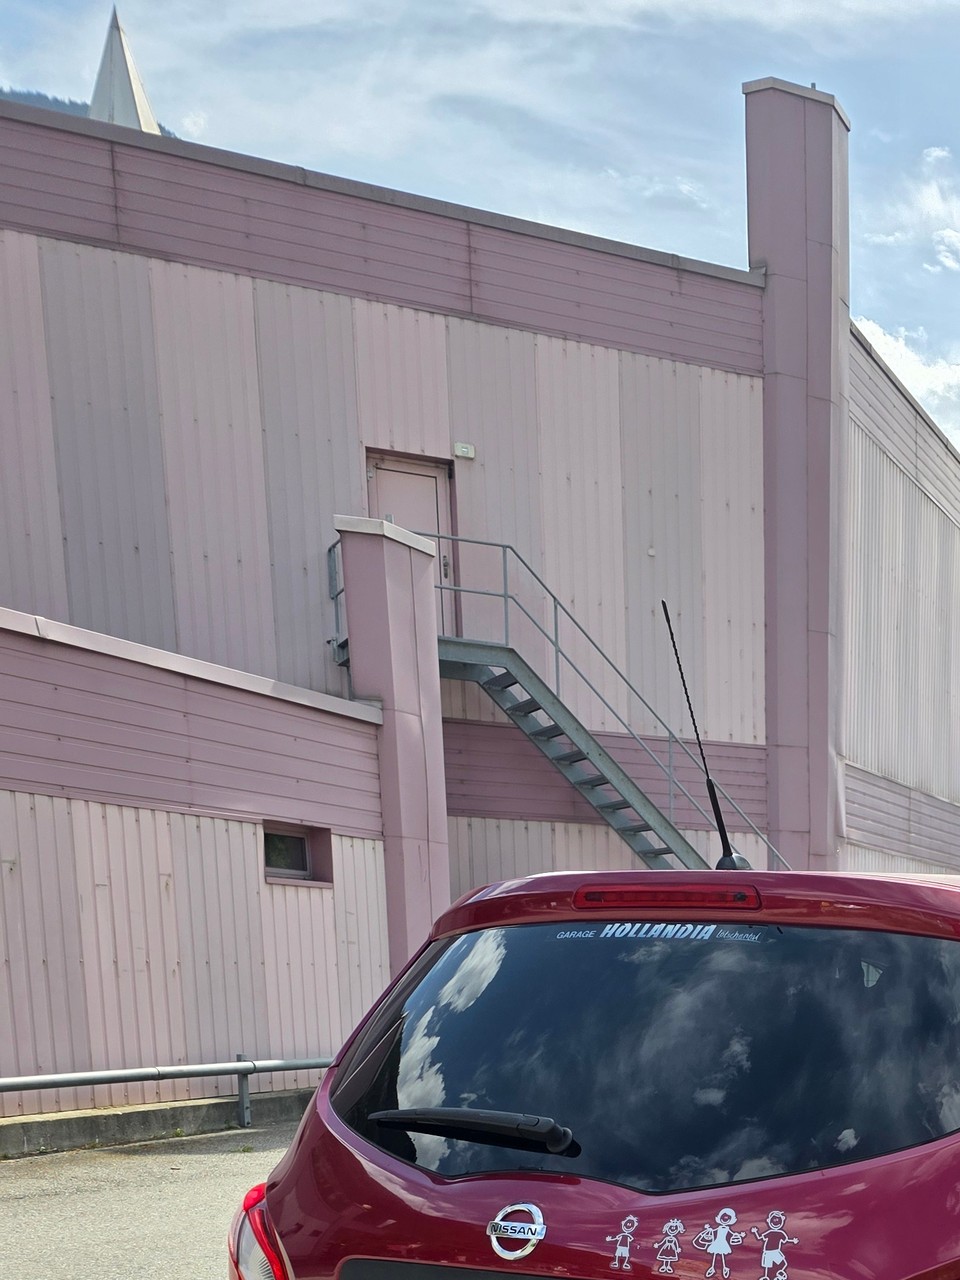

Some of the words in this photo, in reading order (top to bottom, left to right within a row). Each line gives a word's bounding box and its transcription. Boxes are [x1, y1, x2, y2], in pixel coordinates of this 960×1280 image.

[556, 930, 597, 939] GARAGE
[599, 922, 717, 940] HOLLANDIA
[490, 1224, 537, 1236] NISSAN
